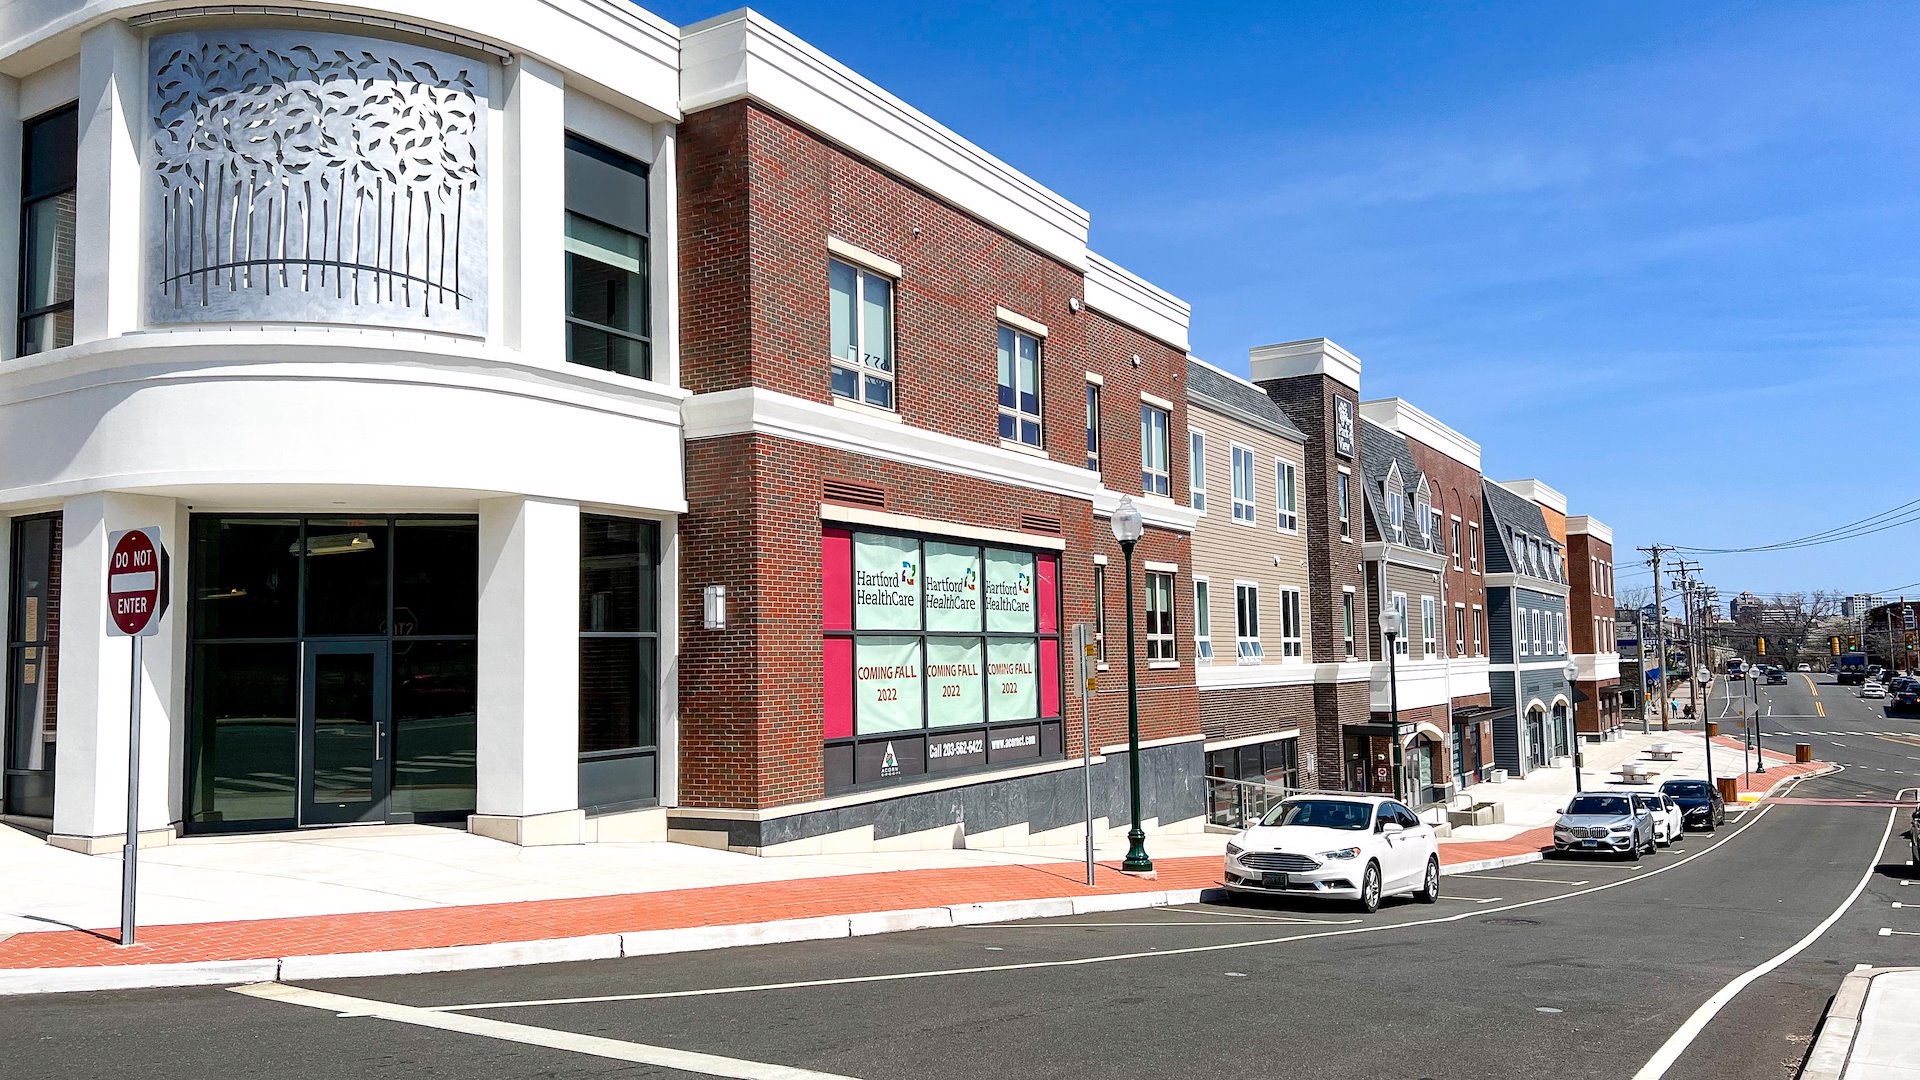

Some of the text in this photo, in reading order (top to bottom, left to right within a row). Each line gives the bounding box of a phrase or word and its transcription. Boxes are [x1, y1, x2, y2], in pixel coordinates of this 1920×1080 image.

[115, 549, 153, 569] DO NOT
[857, 570, 899, 588] Hartford
[926, 576, 964, 593] Hartford
[986, 580, 1018, 596] Hartford
[117, 596, 147, 614] ENTER
[857, 589, 914, 607] HealthCare
[926, 594, 976, 610] HealthCare
[986, 596, 1030, 612] HealthCare
[857, 665, 917, 680] COMING FALL
[926, 664, 979, 677] COMING FALL
[987, 662, 1033, 676] COMING FALL
[877, 688, 898, 702] 2022
[942, 685, 961, 698] 2022
[1001, 682, 1018, 694] 2022
[929, 739, 983, 759] Call 203-562-6422
